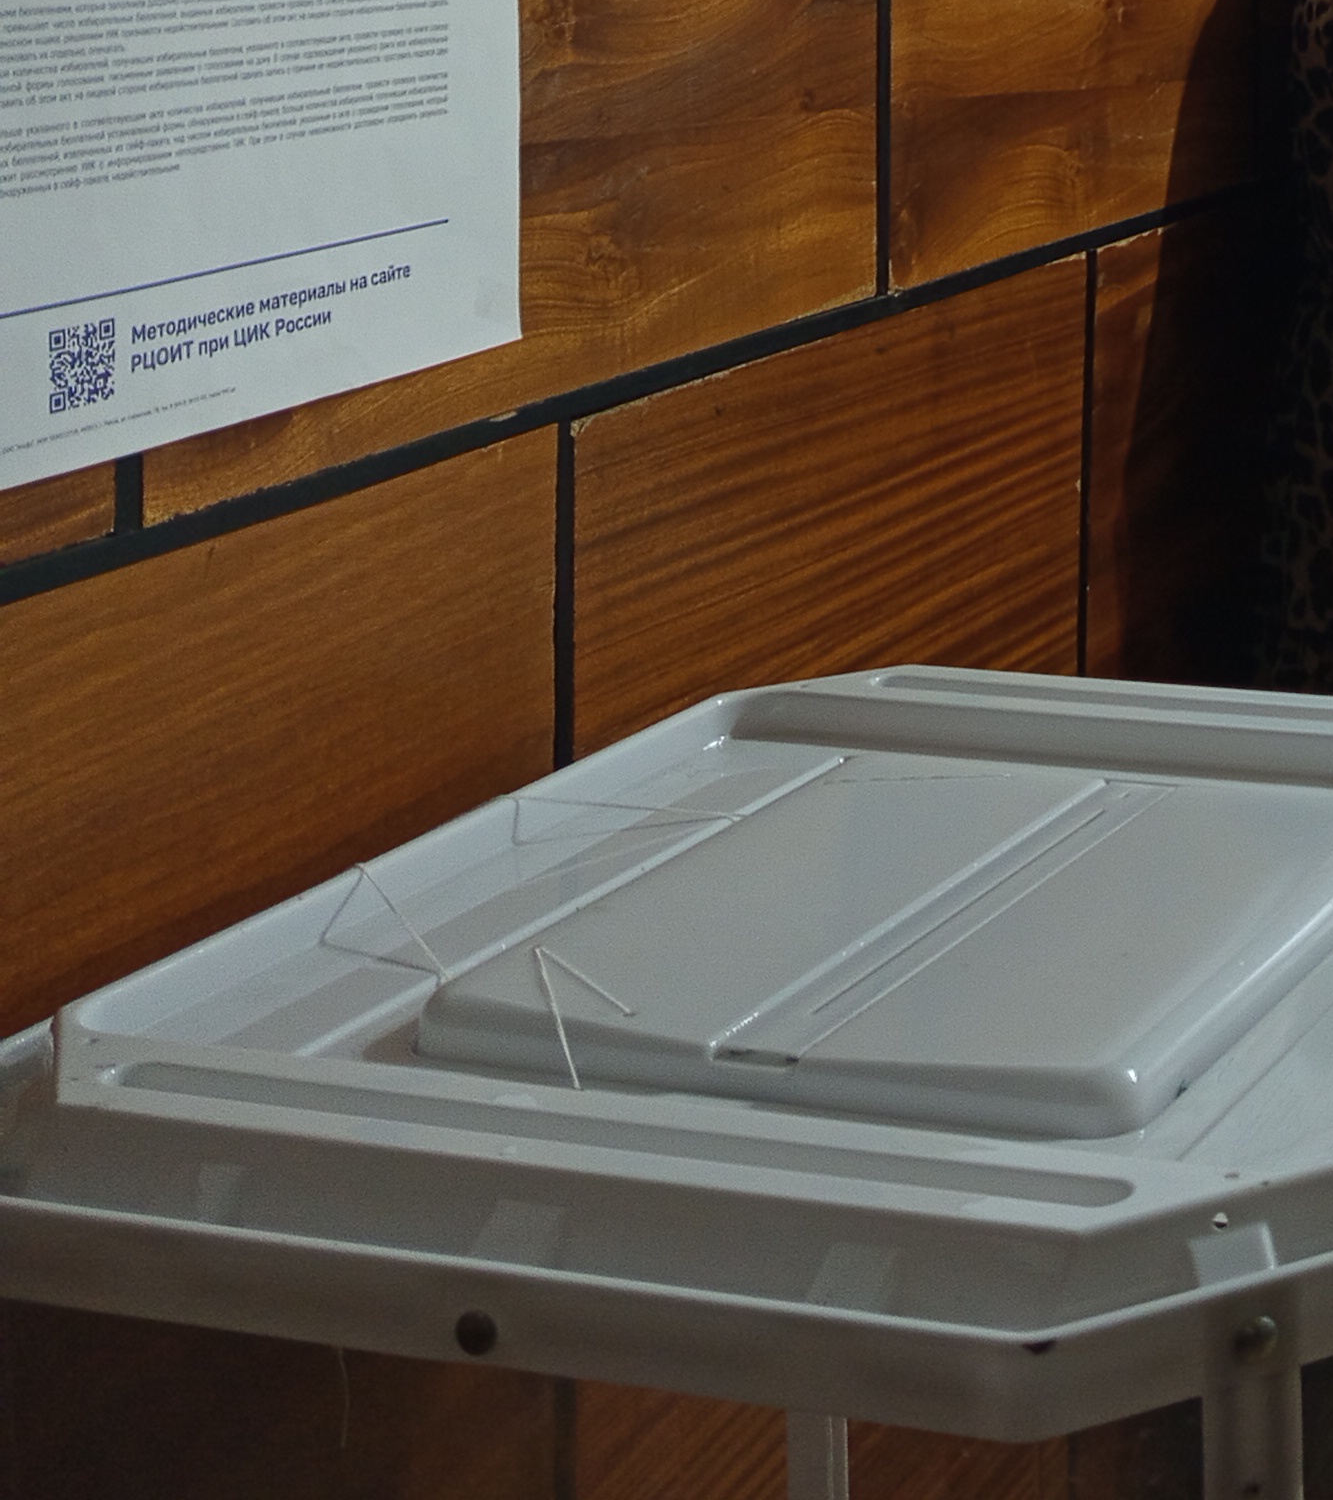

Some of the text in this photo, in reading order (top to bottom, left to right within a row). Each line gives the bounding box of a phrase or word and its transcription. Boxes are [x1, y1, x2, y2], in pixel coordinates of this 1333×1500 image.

[132, 263, 411, 344] Методические материалы на сайте
[131, 309, 332, 372] РЦОИТ при ЦИК России
